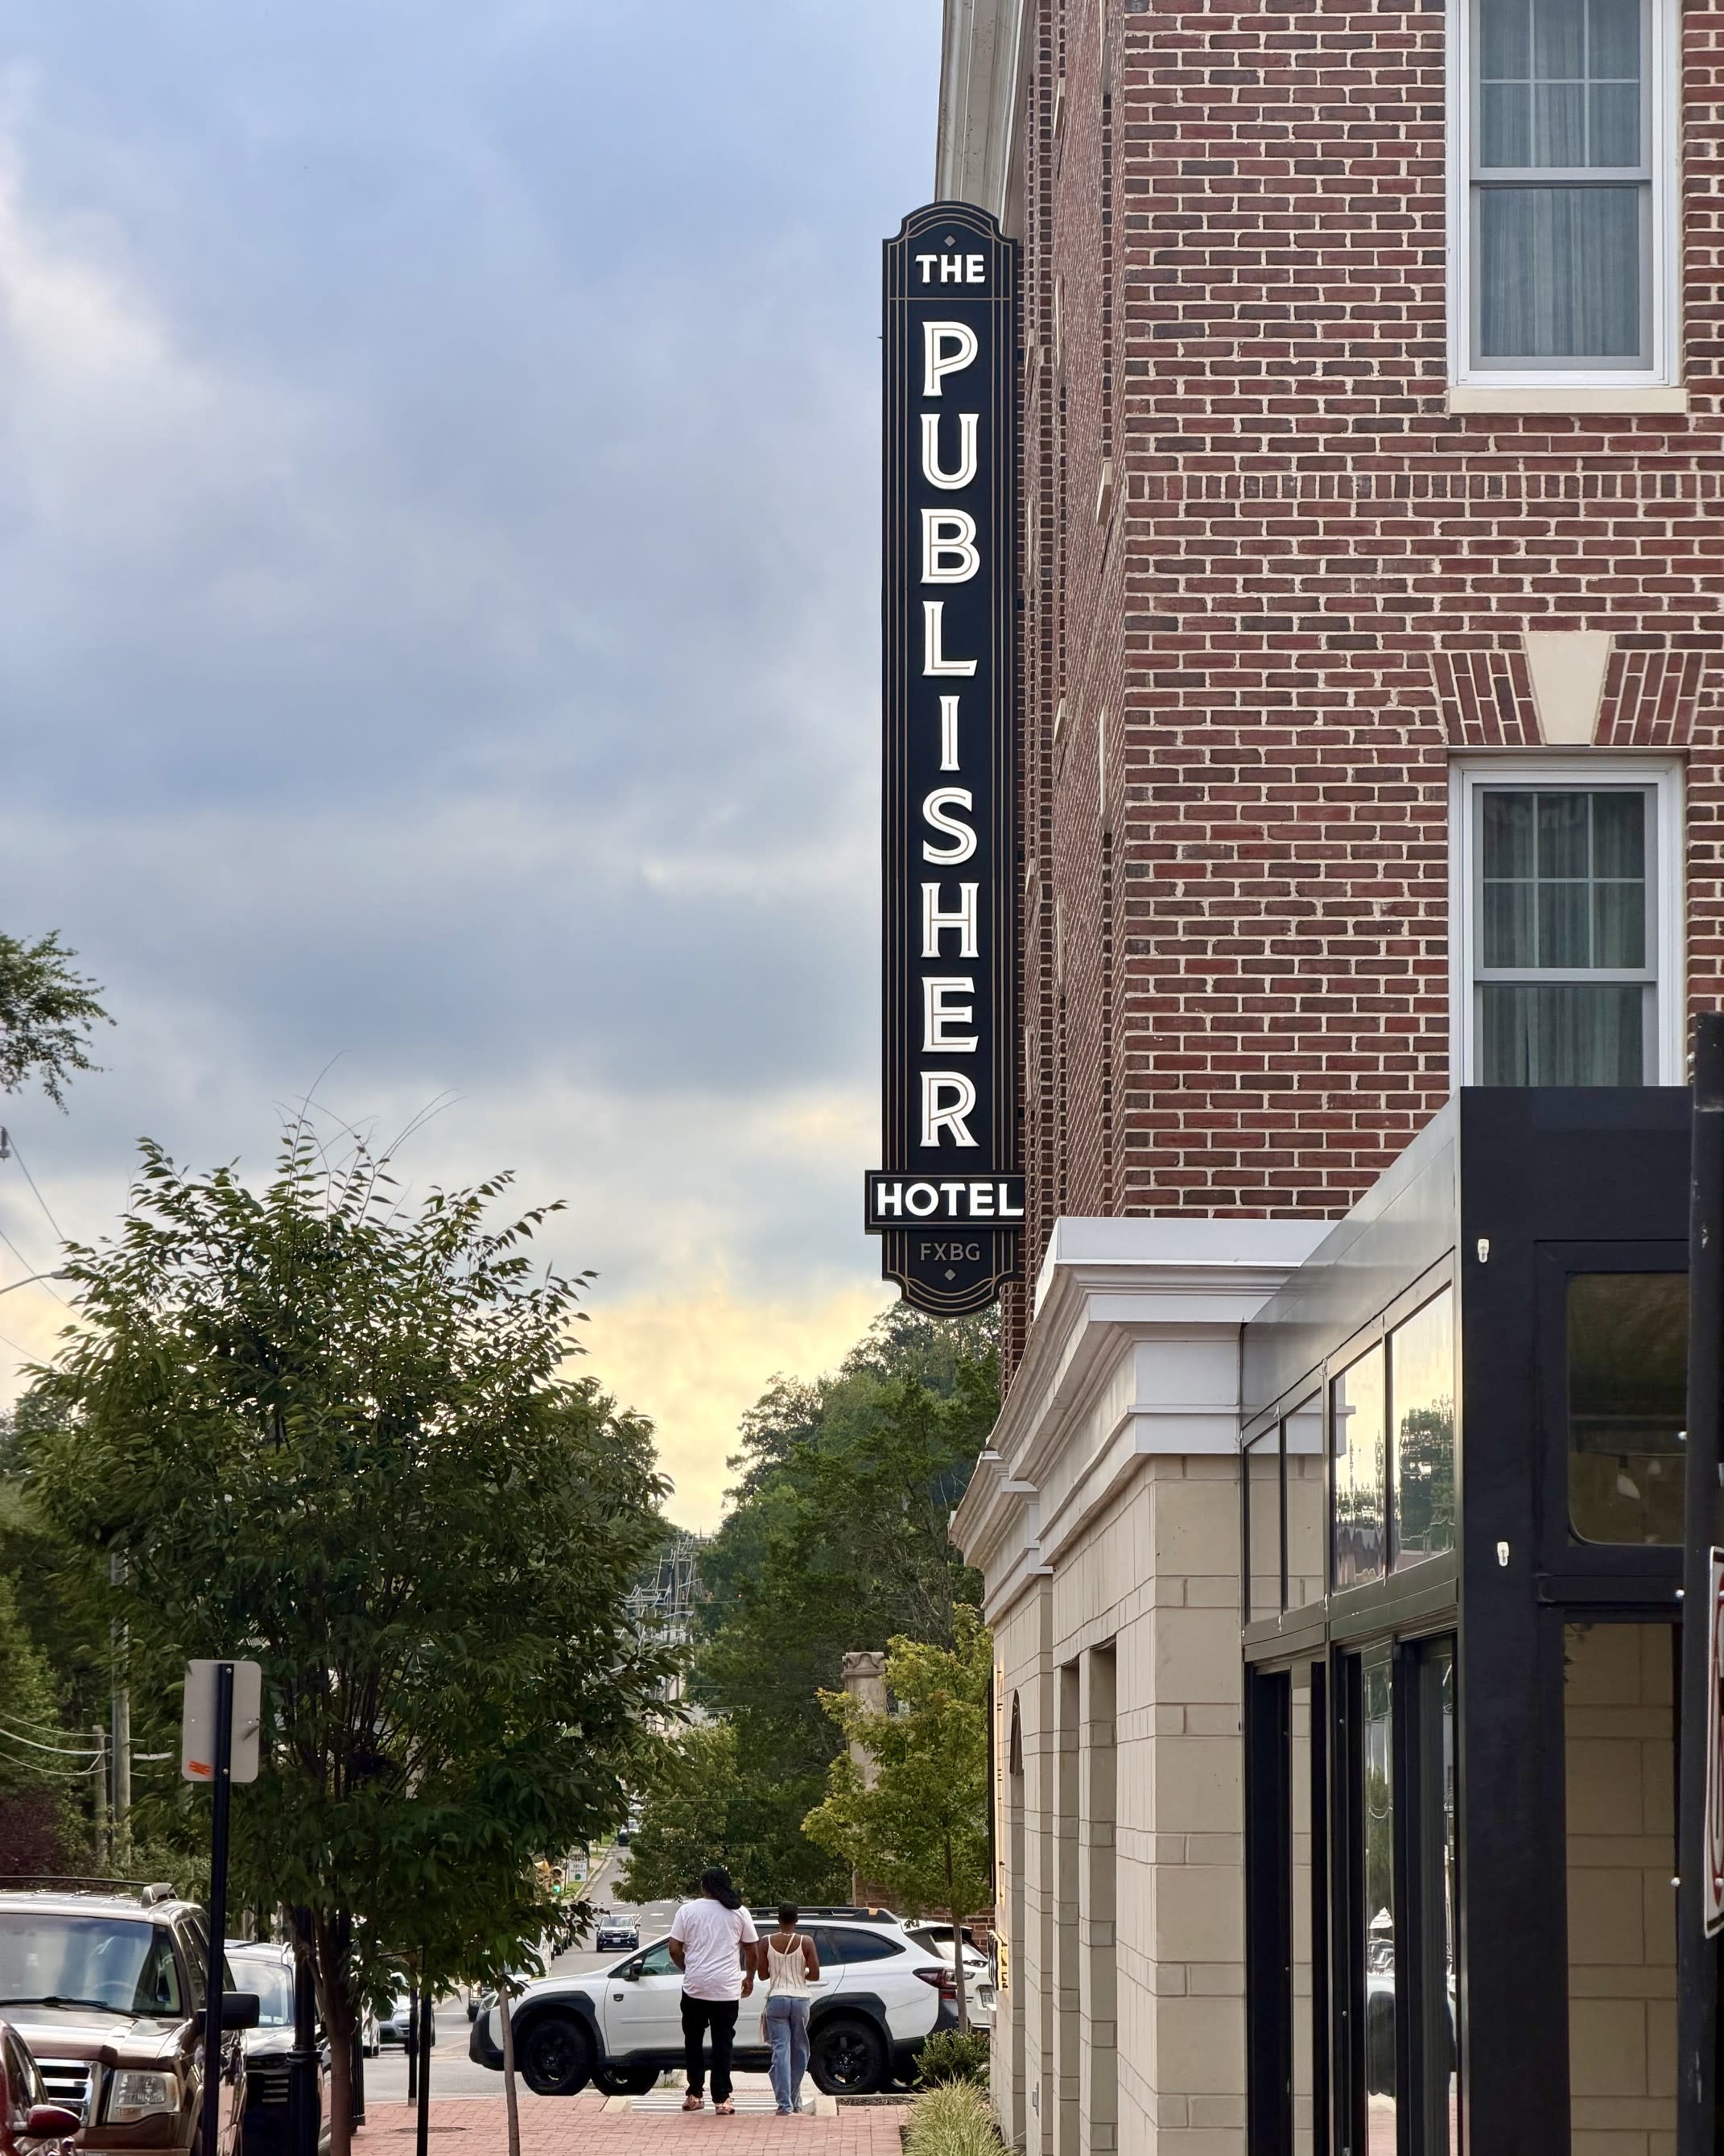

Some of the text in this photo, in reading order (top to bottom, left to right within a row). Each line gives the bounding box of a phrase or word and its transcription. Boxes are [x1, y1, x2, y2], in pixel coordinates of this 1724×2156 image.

[915, 254, 986, 283] THE
[919, 321, 980, 1148] PUBLISHER
[876, 1182, 1025, 1216] HOTEL
[920, 1242, 980, 1261] FXBG
